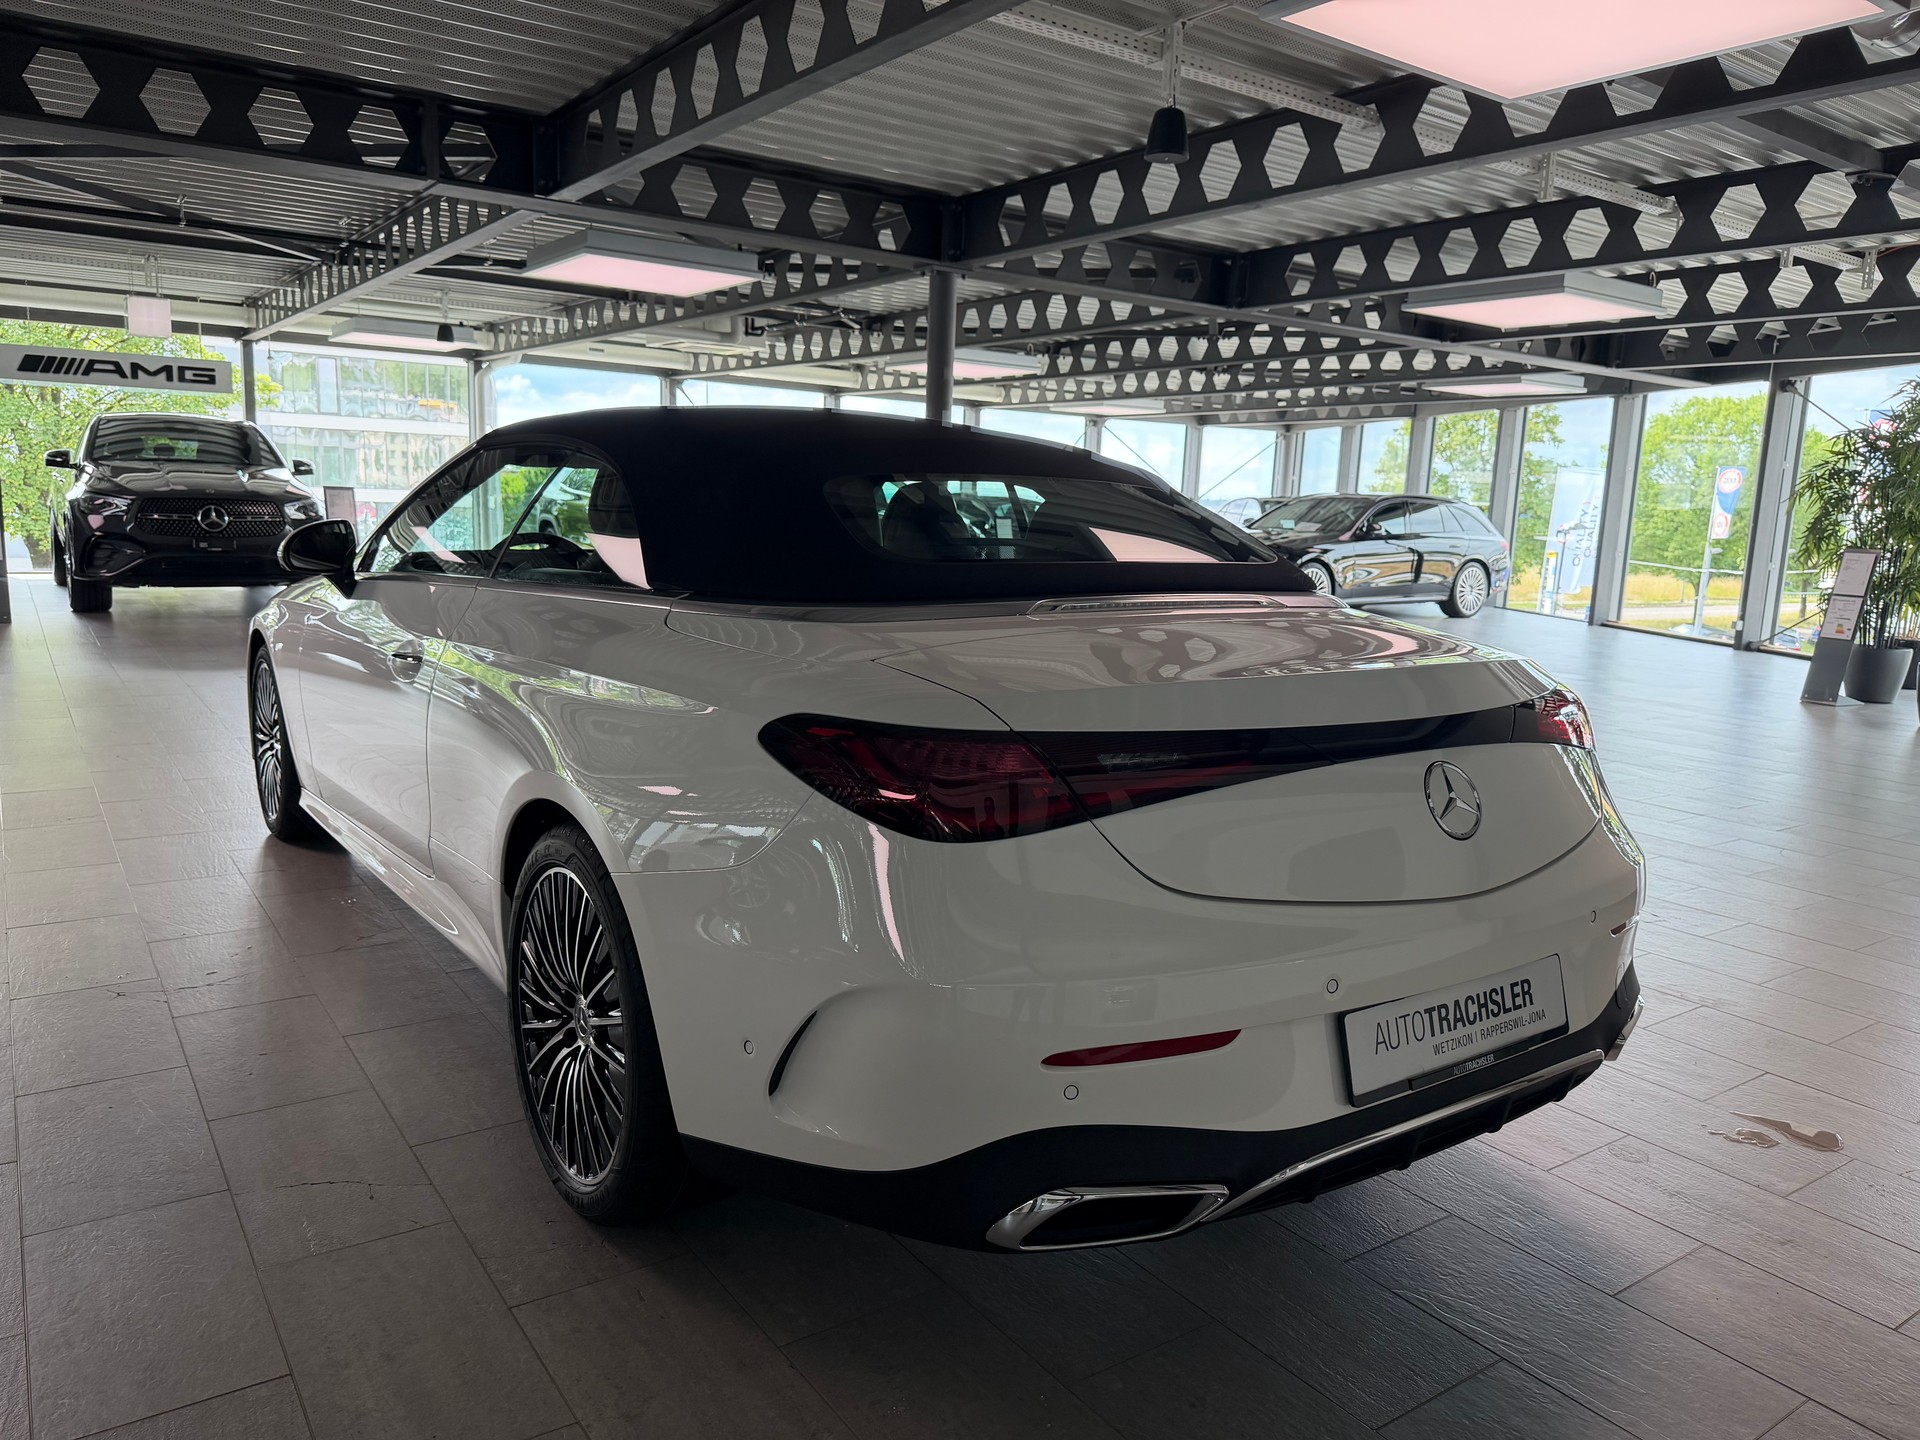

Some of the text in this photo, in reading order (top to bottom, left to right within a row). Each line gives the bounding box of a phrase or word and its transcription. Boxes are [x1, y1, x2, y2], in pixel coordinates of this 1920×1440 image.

[82, 358, 216, 385] AMG
[1572, 508, 1589, 567] QUALTY
[1375, 978, 1535, 1056] AUTOTRACHSLER
[1432, 1032, 1474, 1056] WETZIKON
[1480, 1009, 1547, 1041] RAPPERSWIL-JONA
[1453, 1053, 1495, 1076] AUTOTRACHSLER
